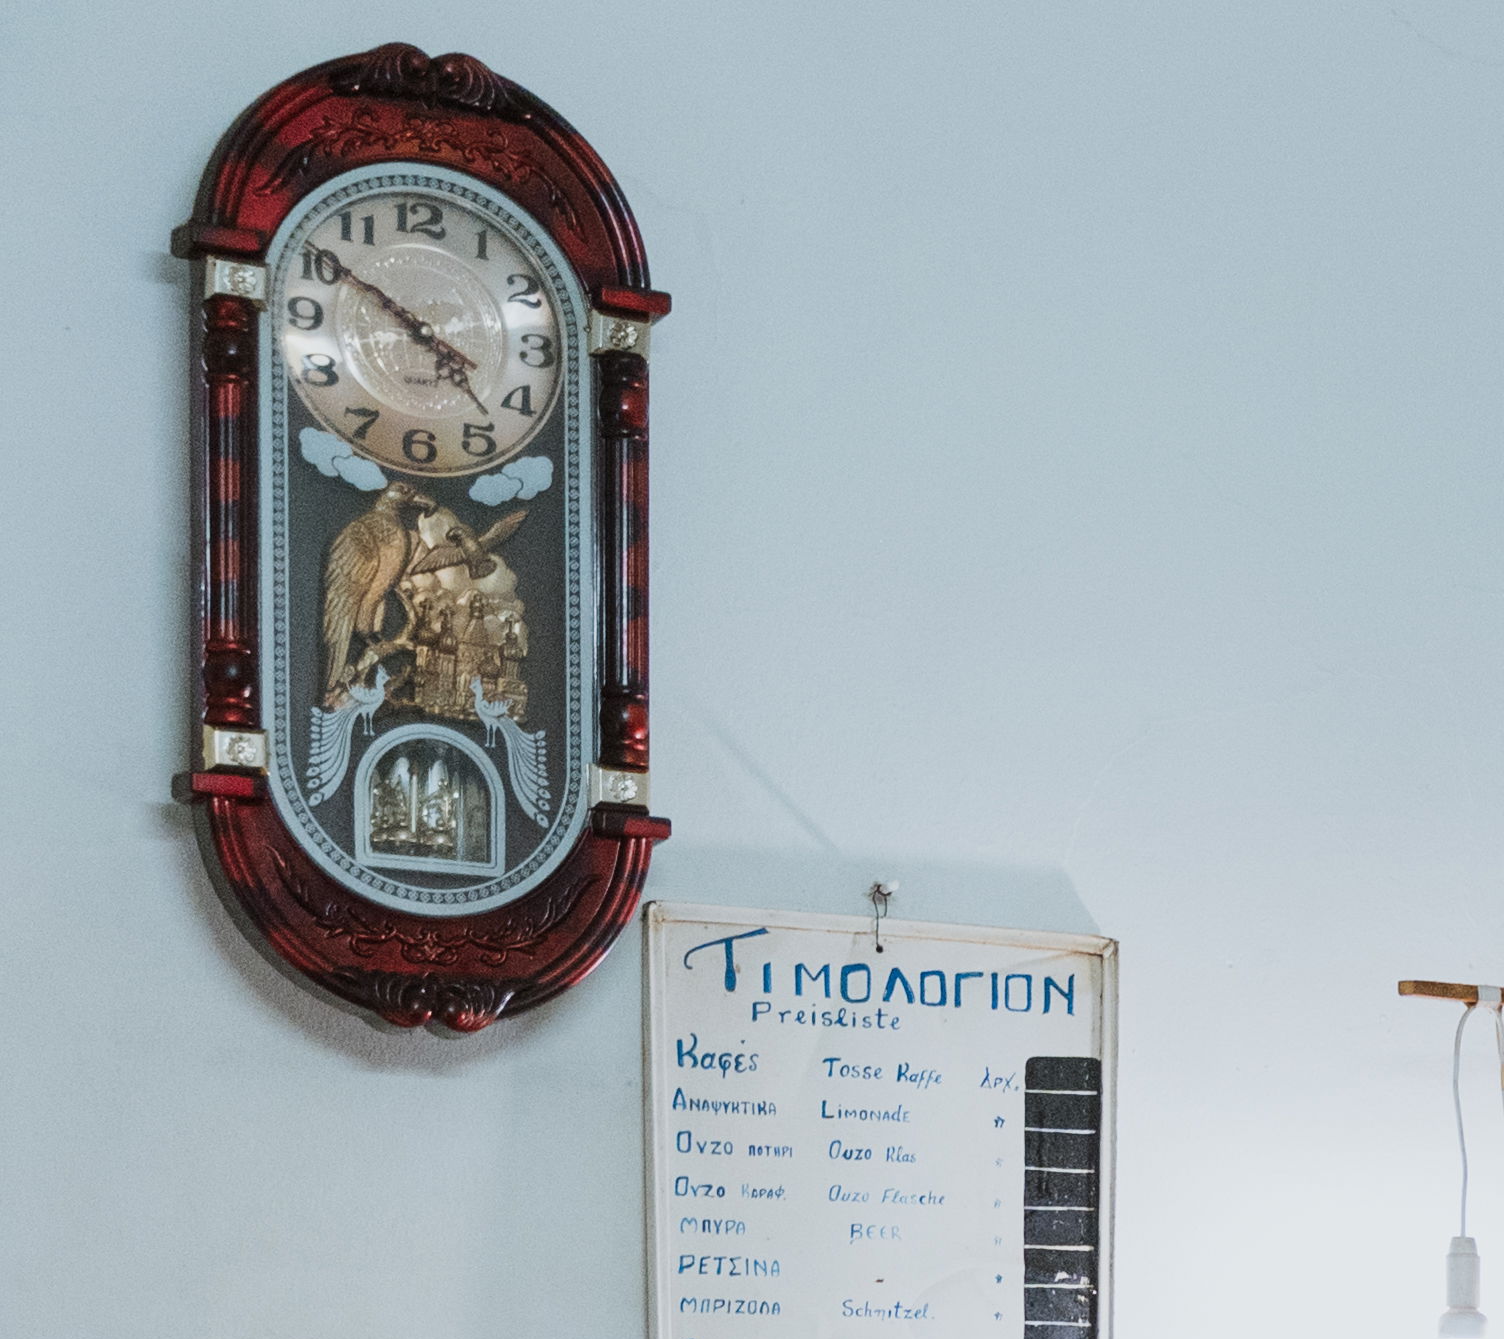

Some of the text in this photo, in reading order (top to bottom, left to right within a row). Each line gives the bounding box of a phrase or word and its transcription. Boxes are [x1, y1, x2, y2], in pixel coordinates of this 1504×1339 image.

[339, 211, 376, 246] 11
[395, 201, 447, 240] 12
[474, 228, 489, 260] 1
[302, 249, 341, 286] 10
[507, 273, 542, 309] 2
[288, 296, 324, 331] 9
[519, 333, 554, 370] 3
[302, 352, 341, 387] 8
[500, 384, 536, 418] 4
[343, 406, 380, 442] 7
[461, 422, 497, 458] 5
[401, 429, 438, 465] 6
[752, 1001, 901, 1031] Preisliste
[882, 1187, 946, 1207] Flasche
[680, 1217, 746, 1236] ΜΠΥΡΑ
[849, 1223, 902, 1243] BEER
[678, 1254, 781, 1278] ΡΕΤΣΙΝΑ
[679, 1297, 781, 1318] ΜΠΡΙΖΟΛΑ
